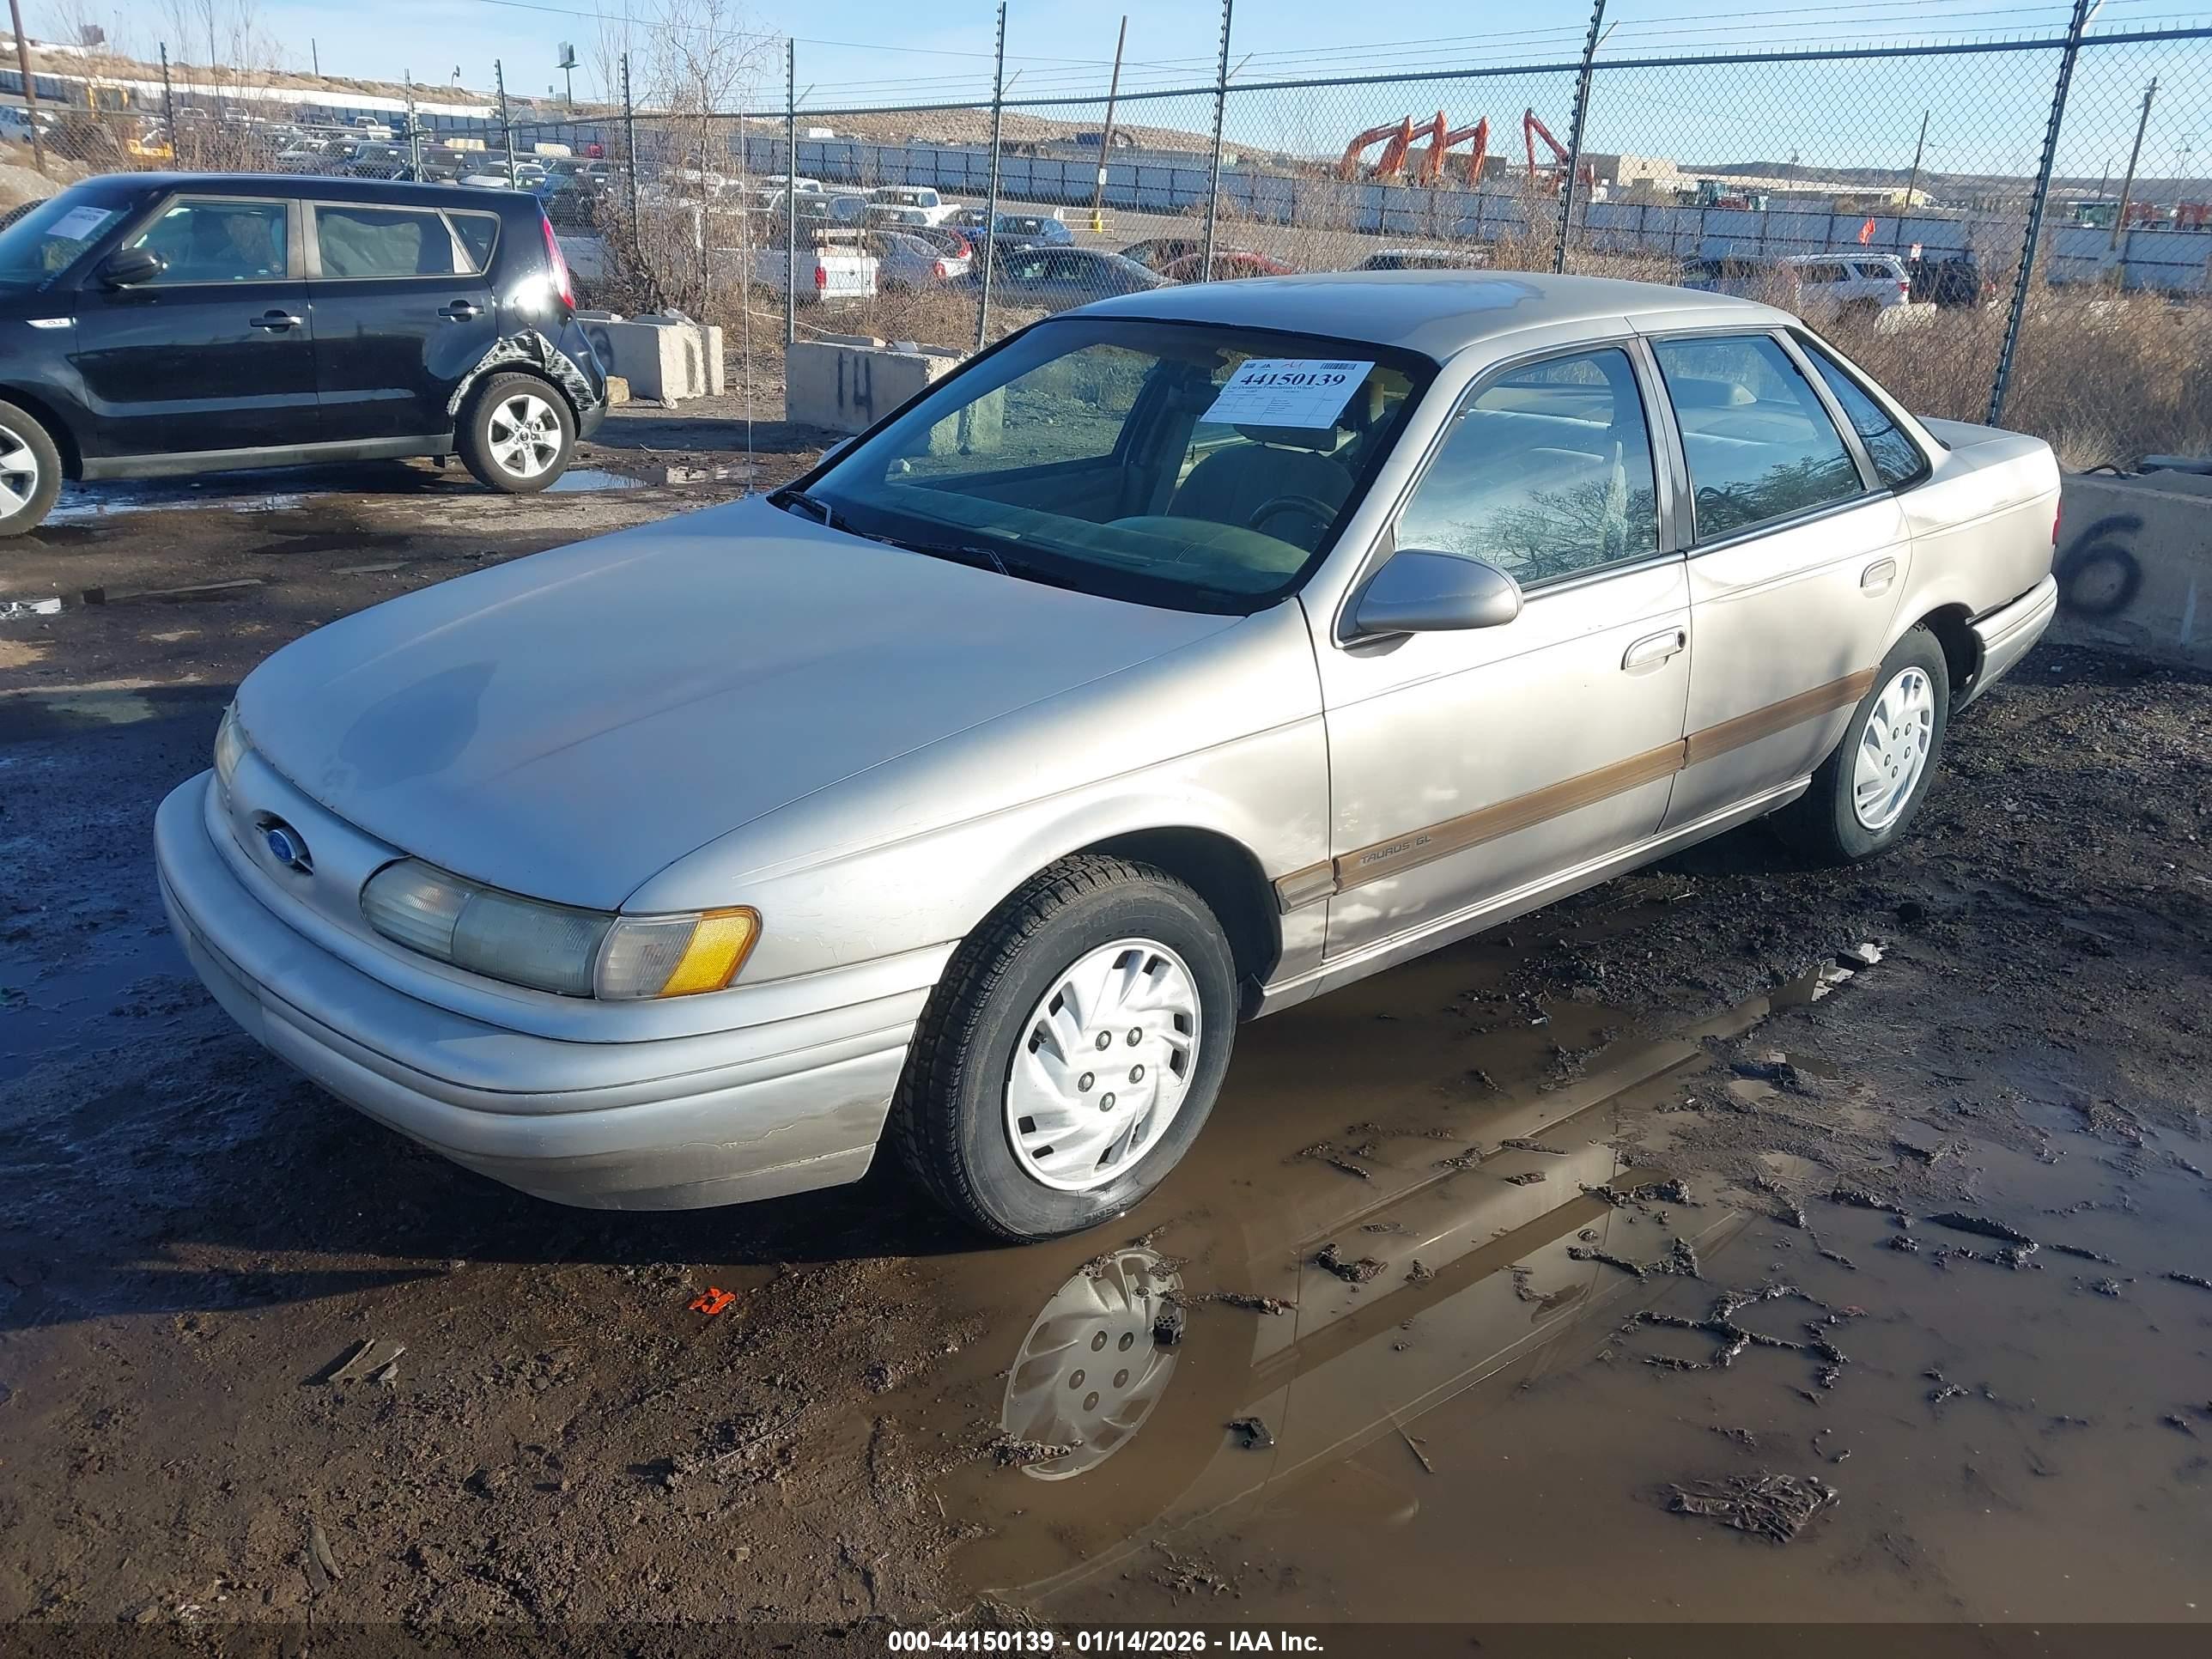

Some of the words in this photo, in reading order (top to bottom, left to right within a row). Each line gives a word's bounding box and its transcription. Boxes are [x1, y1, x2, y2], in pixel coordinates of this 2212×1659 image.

[837, 349, 873, 424] 14
[1240, 373, 1346, 387] 44150139
[2057, 514, 2144, 620] 6
[1360, 841, 1410, 864] TAURUS
[1416, 836, 1432, 846] GL
